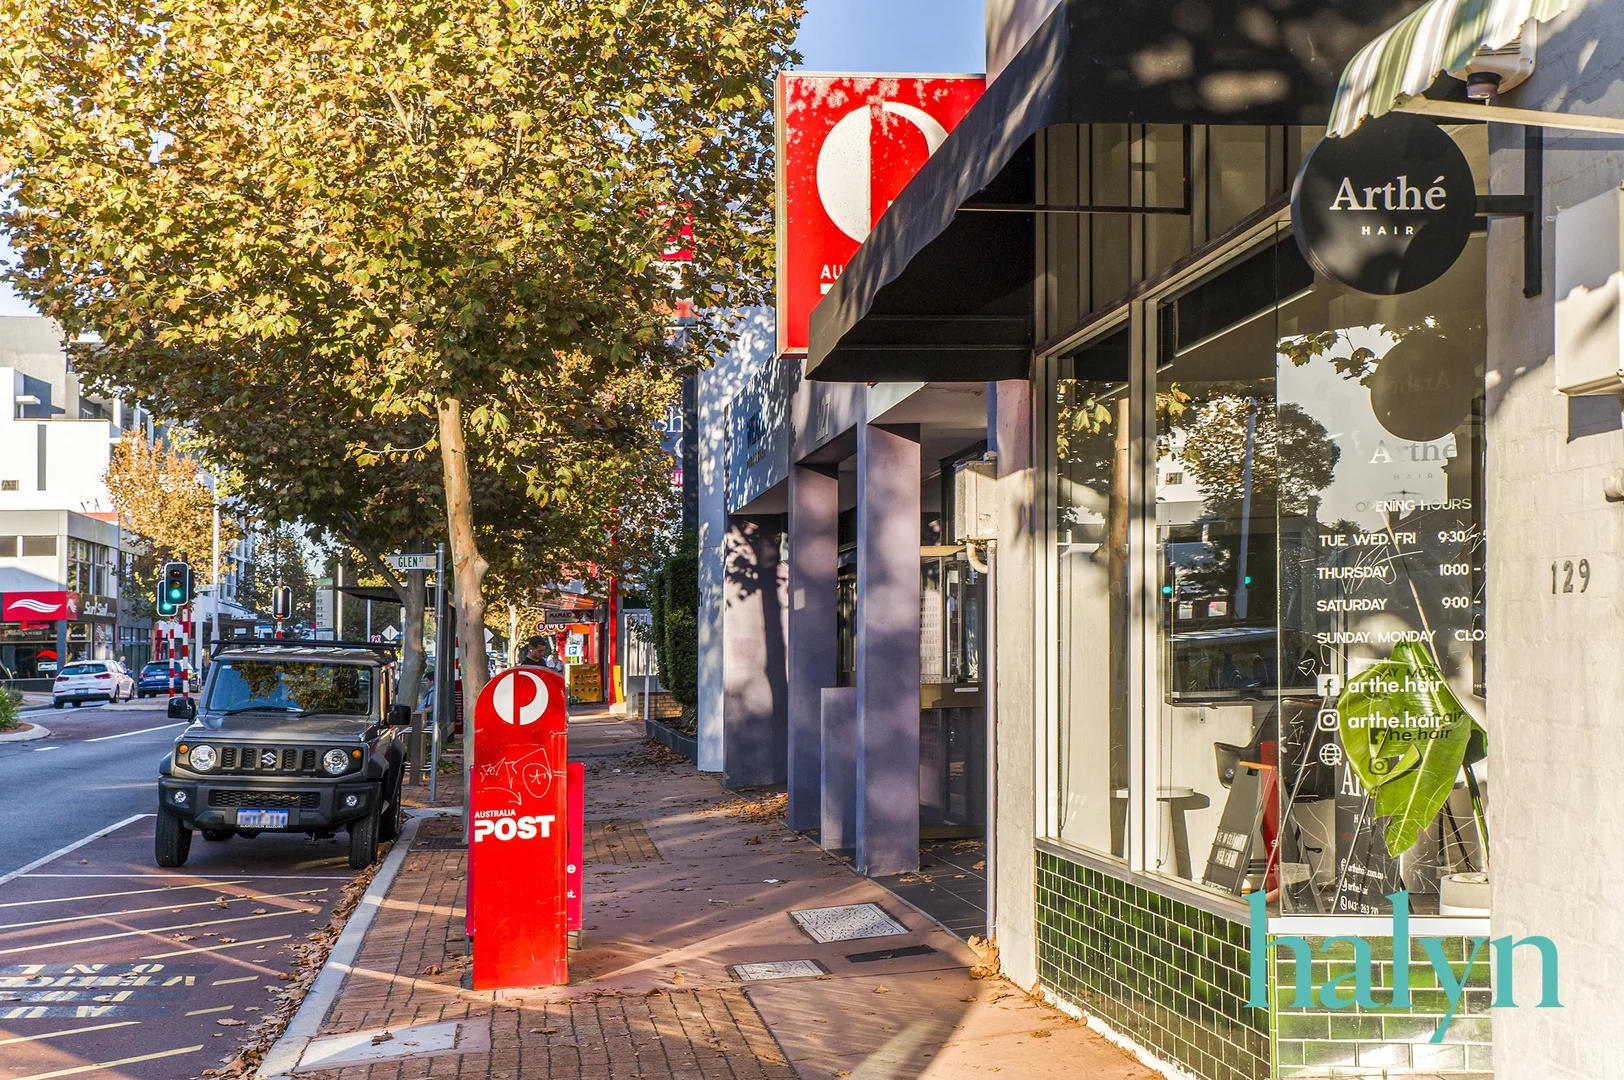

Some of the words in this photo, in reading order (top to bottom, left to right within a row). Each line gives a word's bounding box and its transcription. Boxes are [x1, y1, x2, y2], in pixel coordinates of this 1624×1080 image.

[1328, 174, 1447, 212] Arthé
[1361, 225, 1415, 236] HAIR
[1393, 472, 1434, 481] HAIR
[1355, 499, 1416, 513] OPENING
[1420, 498, 1473, 511] HOURS
[1318, 534, 1349, 547] TUE.
[1352, 533, 1391, 546] WED.
[1394, 532, 1417, 545] FRI
[1437, 530, 1466, 543] 9:30
[398, 556, 418, 568] GLEN
[1316, 565, 1390, 580] THURSDAY
[1439, 563, 1470, 577] 10:00
[1550, 557, 1592, 595] 129
[1316, 598, 1388, 612] SATURDAY
[1441, 596, 1469, 609] 9:00
[1316, 631, 1374, 644] SUNDAY.
[1378, 630, 1437, 643] MONDAY
[1347, 674, 1444, 694] arthe.hair
[454, 690, 463, 725] Landfill
[1347, 710, 1444, 729] arthe.hair
[474, 808, 516, 819] AUSTRALIA
[474, 814, 556, 843] POST
